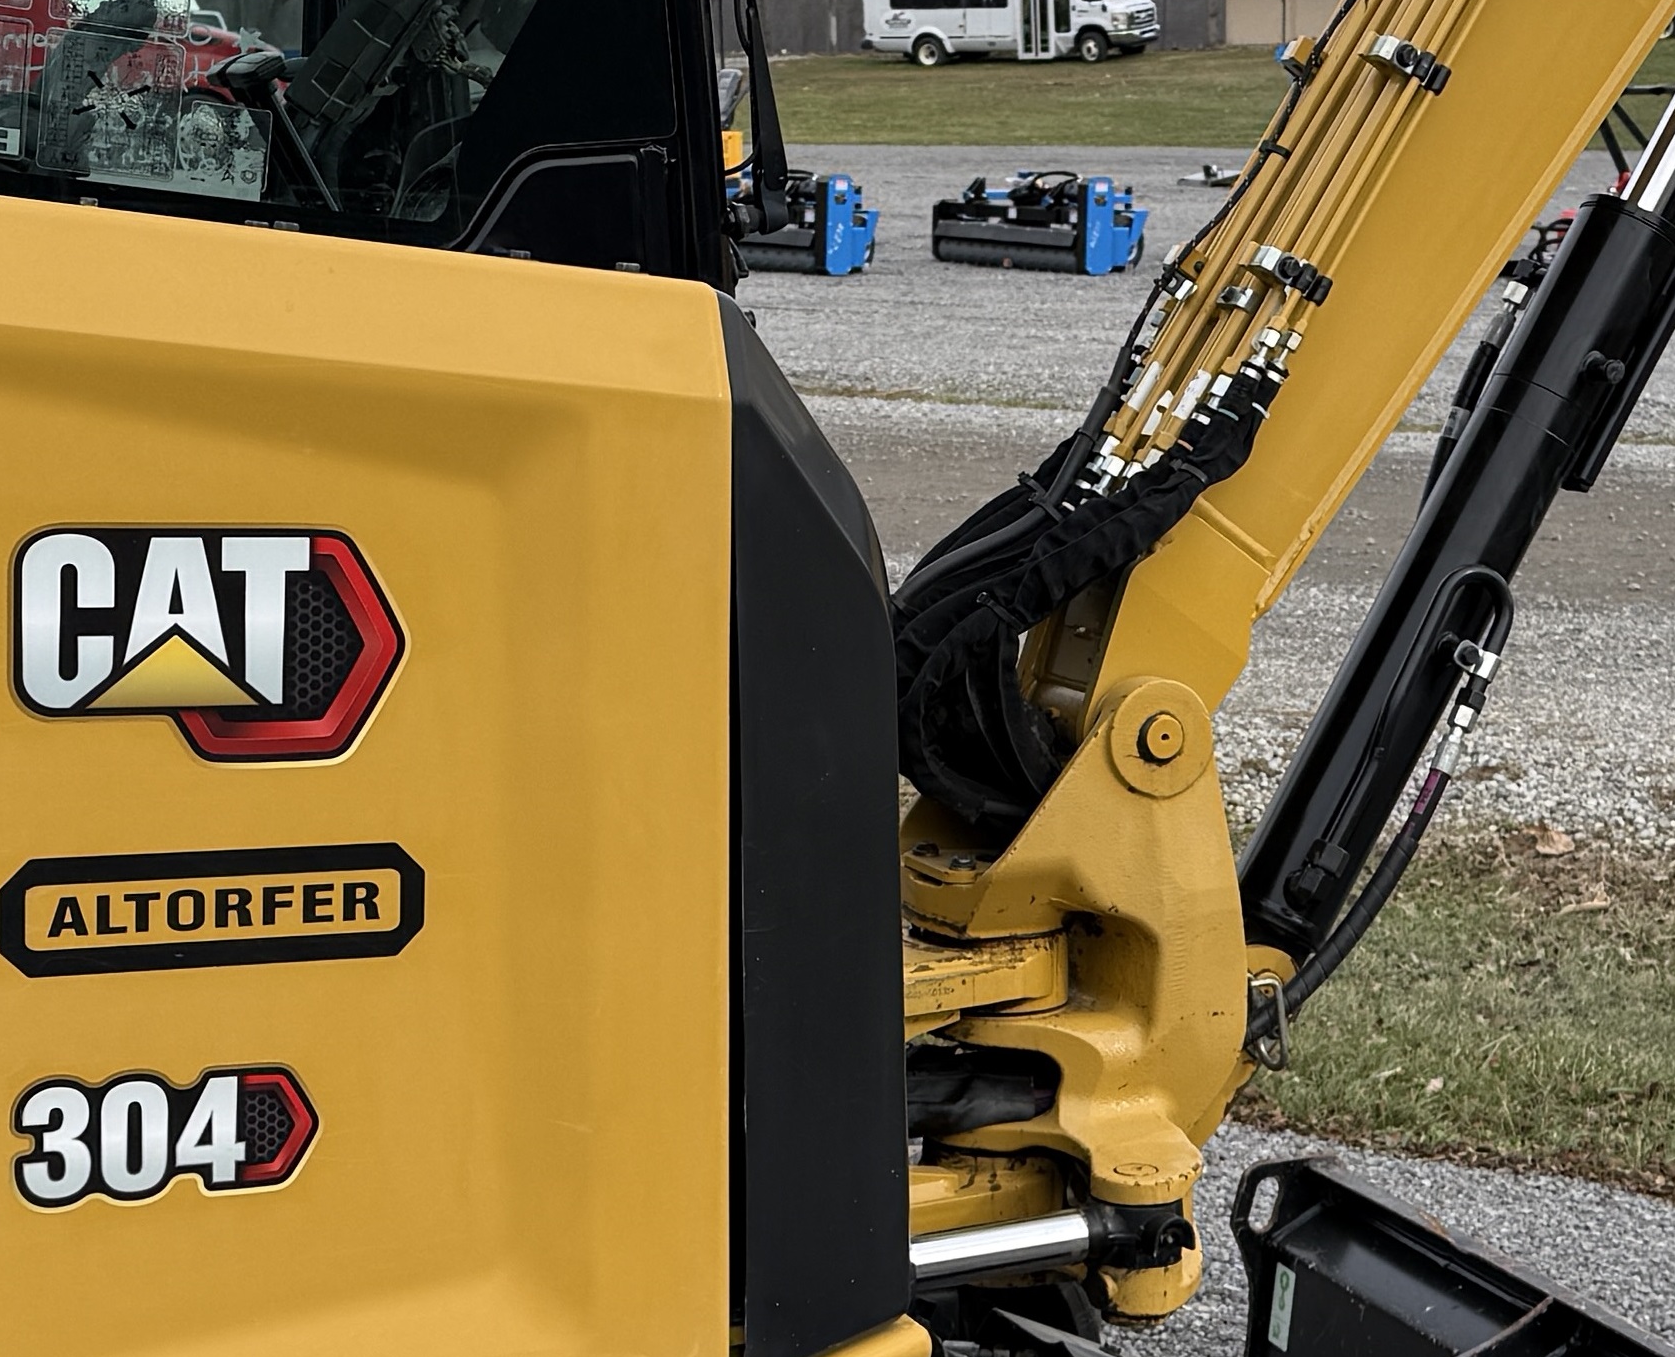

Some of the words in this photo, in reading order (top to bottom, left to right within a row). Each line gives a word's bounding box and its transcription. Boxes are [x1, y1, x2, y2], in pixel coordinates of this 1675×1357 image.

[20, 532, 312, 710] CAT
[46, 880, 382, 940] ALTORFER
[21, 1075, 247, 1201] 304
